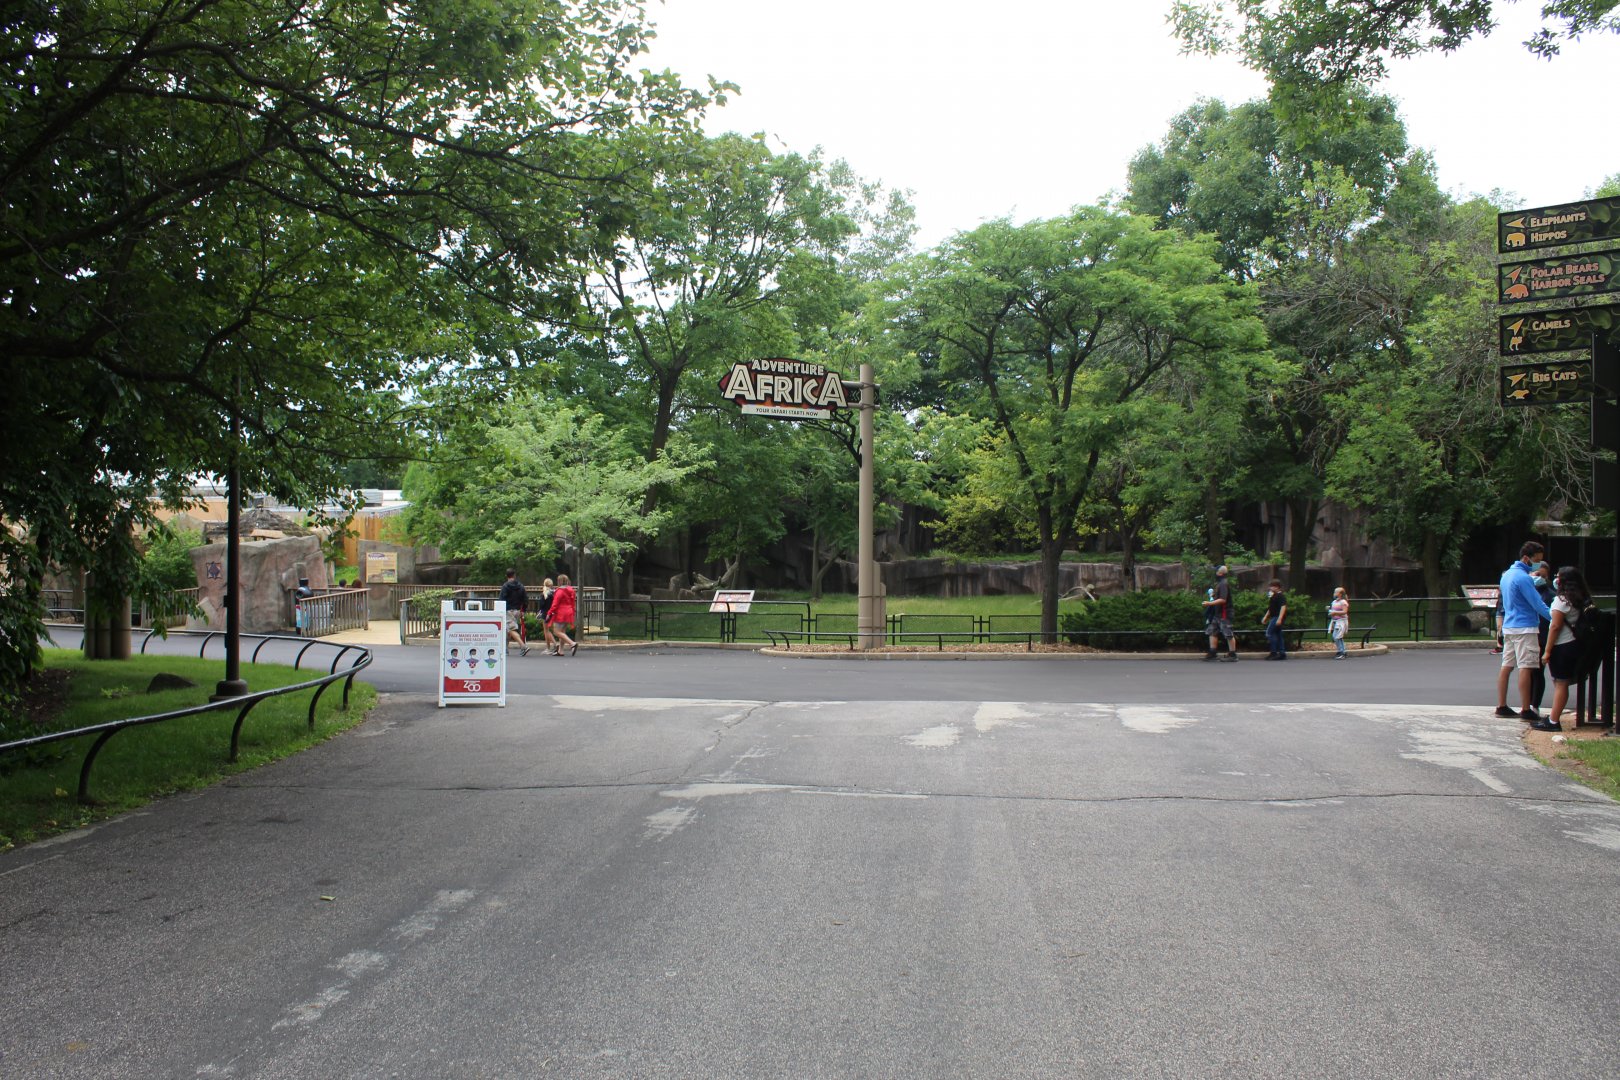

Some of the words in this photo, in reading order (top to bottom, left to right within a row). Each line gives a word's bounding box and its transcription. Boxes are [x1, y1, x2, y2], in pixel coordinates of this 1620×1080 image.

[1530, 212, 1586, 227] ELEPHANTS
[1530, 230, 1567, 243] HIPPOS
[1531, 267, 1563, 278] POLAR
[1565, 263, 1599, 275] BEARS
[1531, 278, 1572, 290] HARBOR
[1572, 274, 1605, 286] SEALS
[1532, 319, 1571, 331] CAMELS
[751, 359, 825, 376] ADVENTURE
[1532, 373, 1551, 383] BIG
[1551, 370, 1577, 382] CATS
[724, 364, 848, 407] AFRICA
